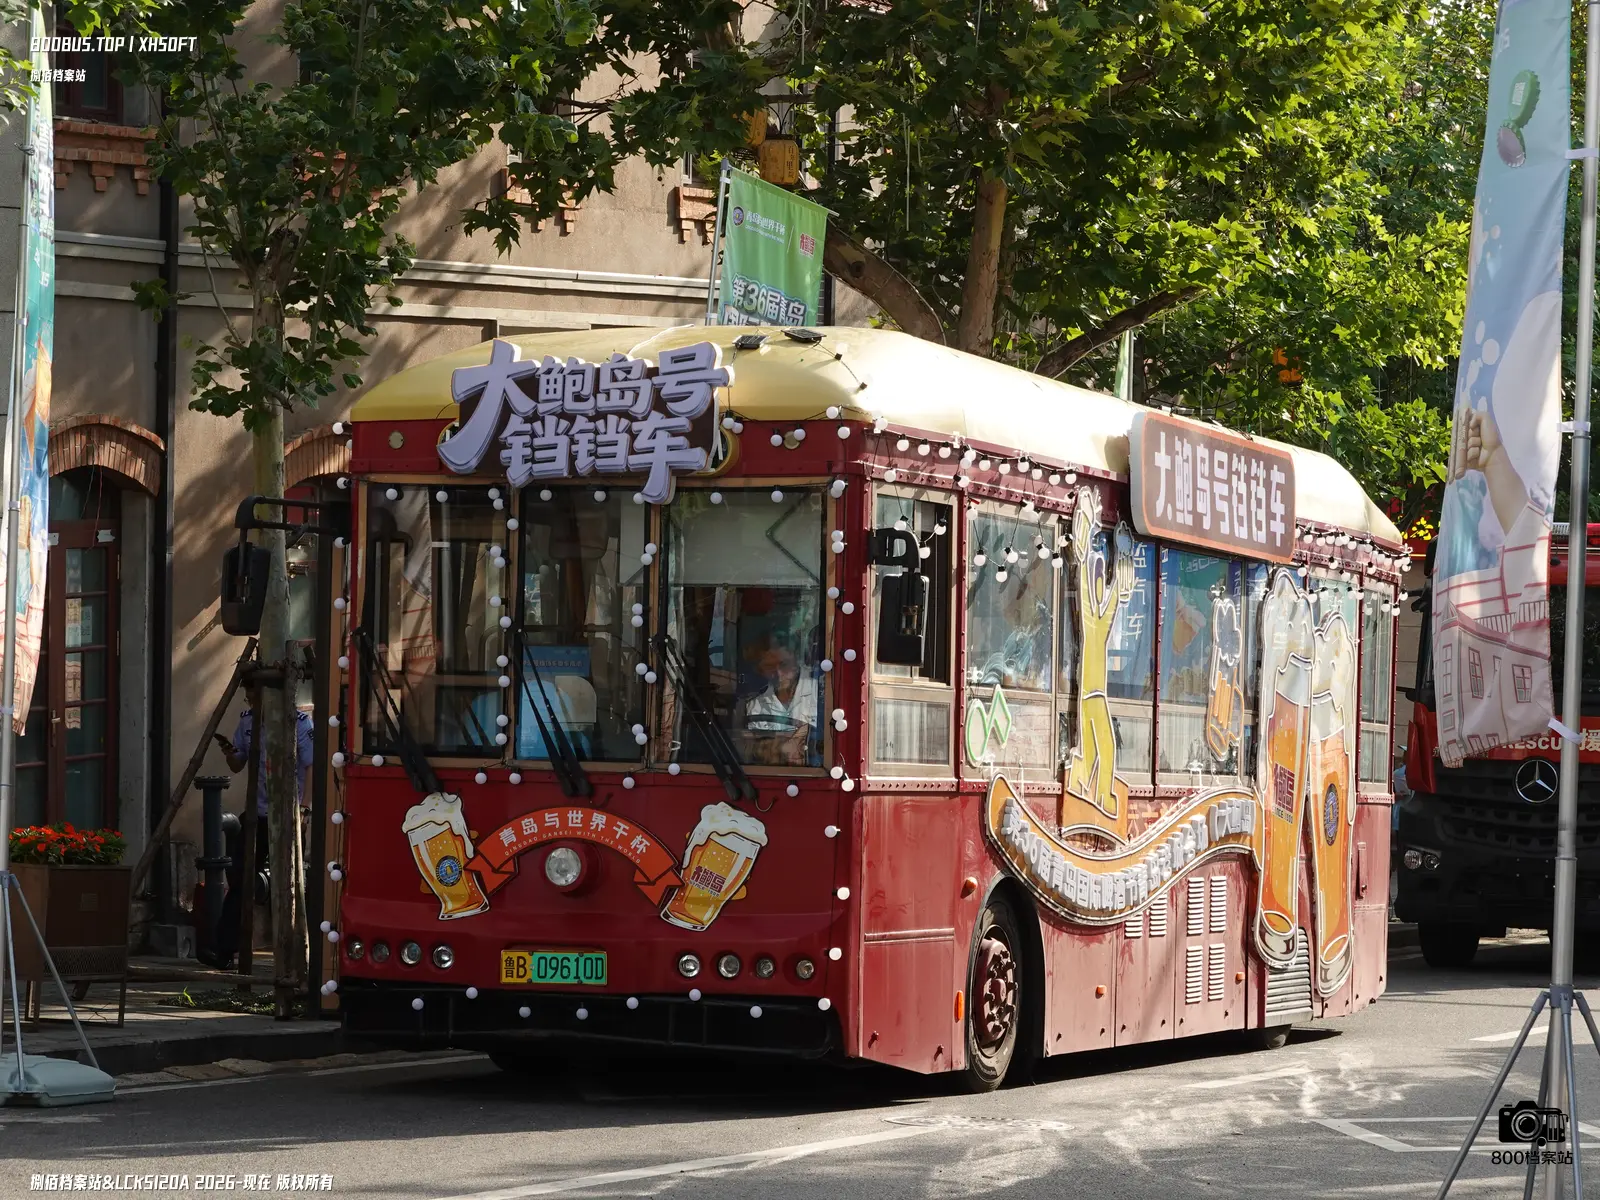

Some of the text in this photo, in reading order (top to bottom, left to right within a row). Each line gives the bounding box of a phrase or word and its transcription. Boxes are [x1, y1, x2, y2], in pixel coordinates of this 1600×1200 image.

[436, 338, 735, 474] 大鲍岛号
[499, 411, 711, 505] 铛铛车
[1154, 431, 1286, 547] 大鲍岛号铛铛车
[498, 810, 651, 854] 青岛与世界干杯
[504, 836, 538, 857] QINGDAO
[576, 830, 596, 839] WITH
[600, 836, 615, 846] THE
[617, 844, 641, 864] WORLD
[504, 955, 604, 980] 鲁B 09610D
